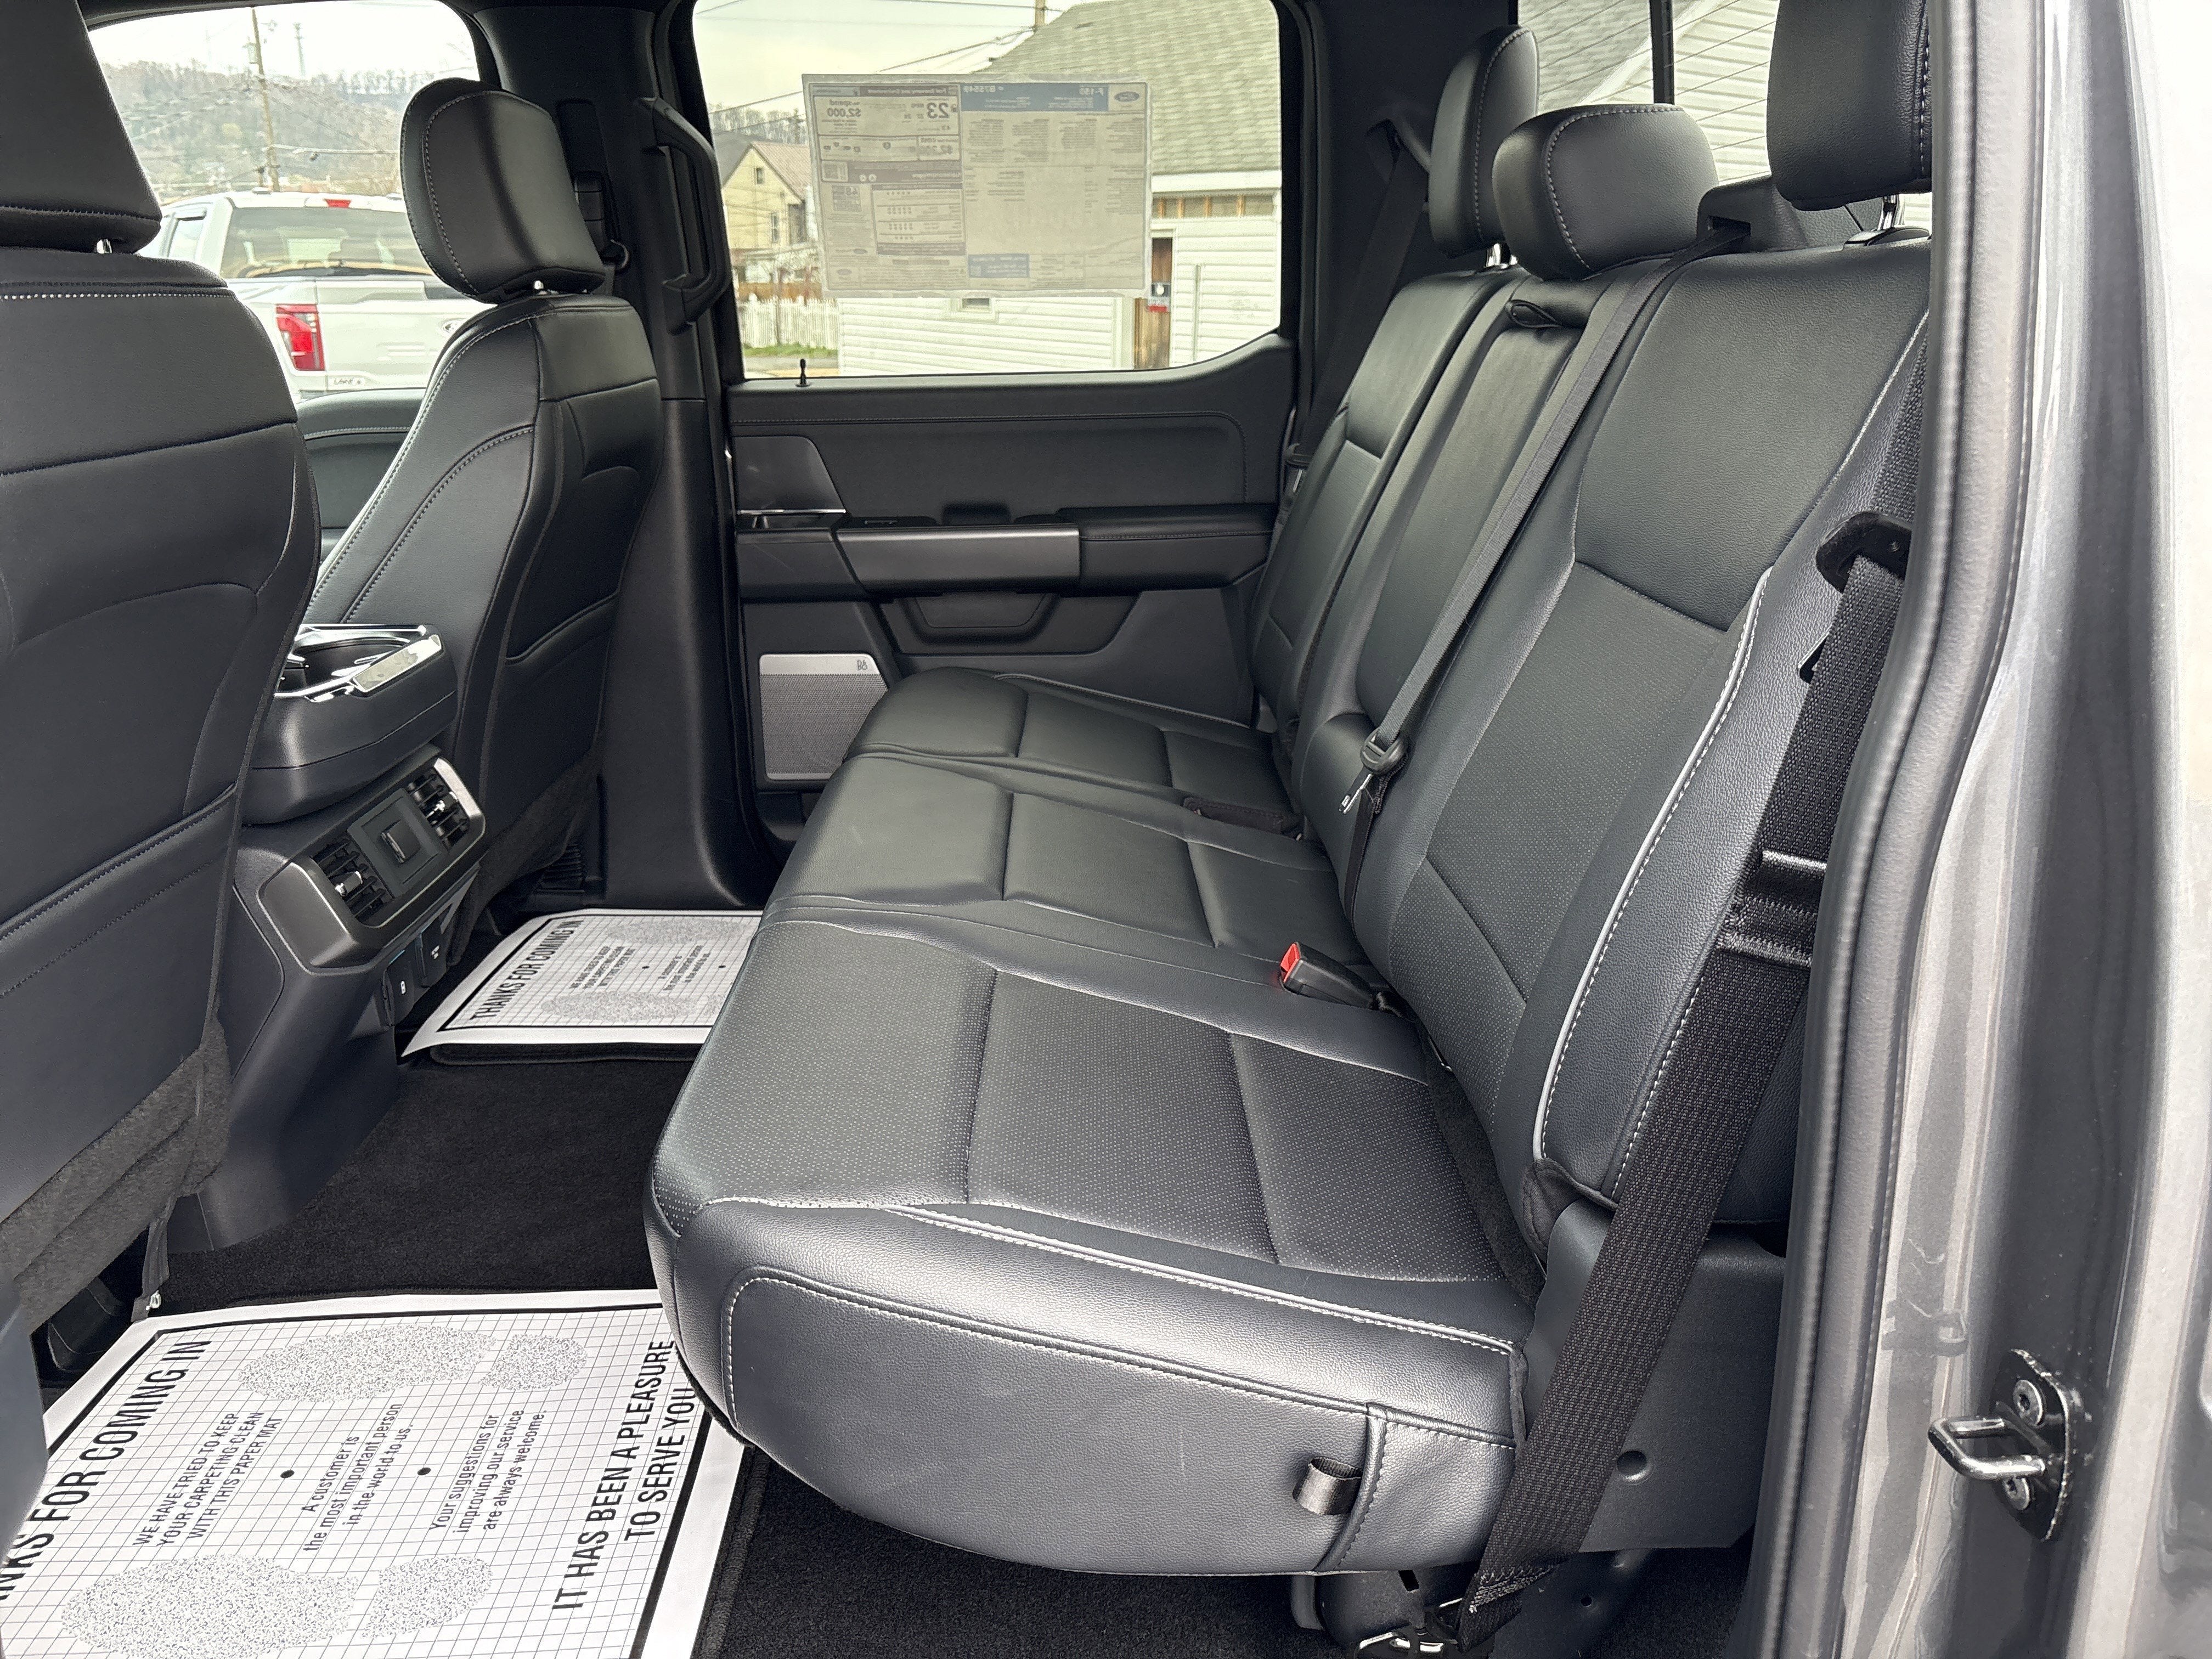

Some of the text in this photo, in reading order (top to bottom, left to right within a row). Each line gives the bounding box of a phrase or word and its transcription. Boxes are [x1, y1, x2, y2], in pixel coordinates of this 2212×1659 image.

[469, 983, 526, 1020] THANKS
[506, 963, 545, 980] FOR
[524, 929, 575, 961] COMING
[27, 1470, 107, 1521] FOR
[79, 1369, 190, 1461] COMING
[161, 1340, 212, 1361] IN
[132, 1413, 239, 1545] WE HAVE TRIED TO KEEP
[156, 1412, 264, 1547] YOUR CARPETING CLEAN
[187, 1418, 283, 1539] WITH THIS PAPER MAT
[301, 1436, 359, 1512] A customer is
[302, 1403, 403, 1551] the most important person
[342, 1424, 414, 1525] in the world to us.
[428, 1415, 499, 1531] Your suggestions for
[453, 1410, 524, 1533] improving our service
[483, 1410, 547, 1530] are always welcome.
[552, 1340, 674, 1610] IT HAS BEEN A PLEASURE
[624, 1387, 697, 1541] TO SERVE YOU
